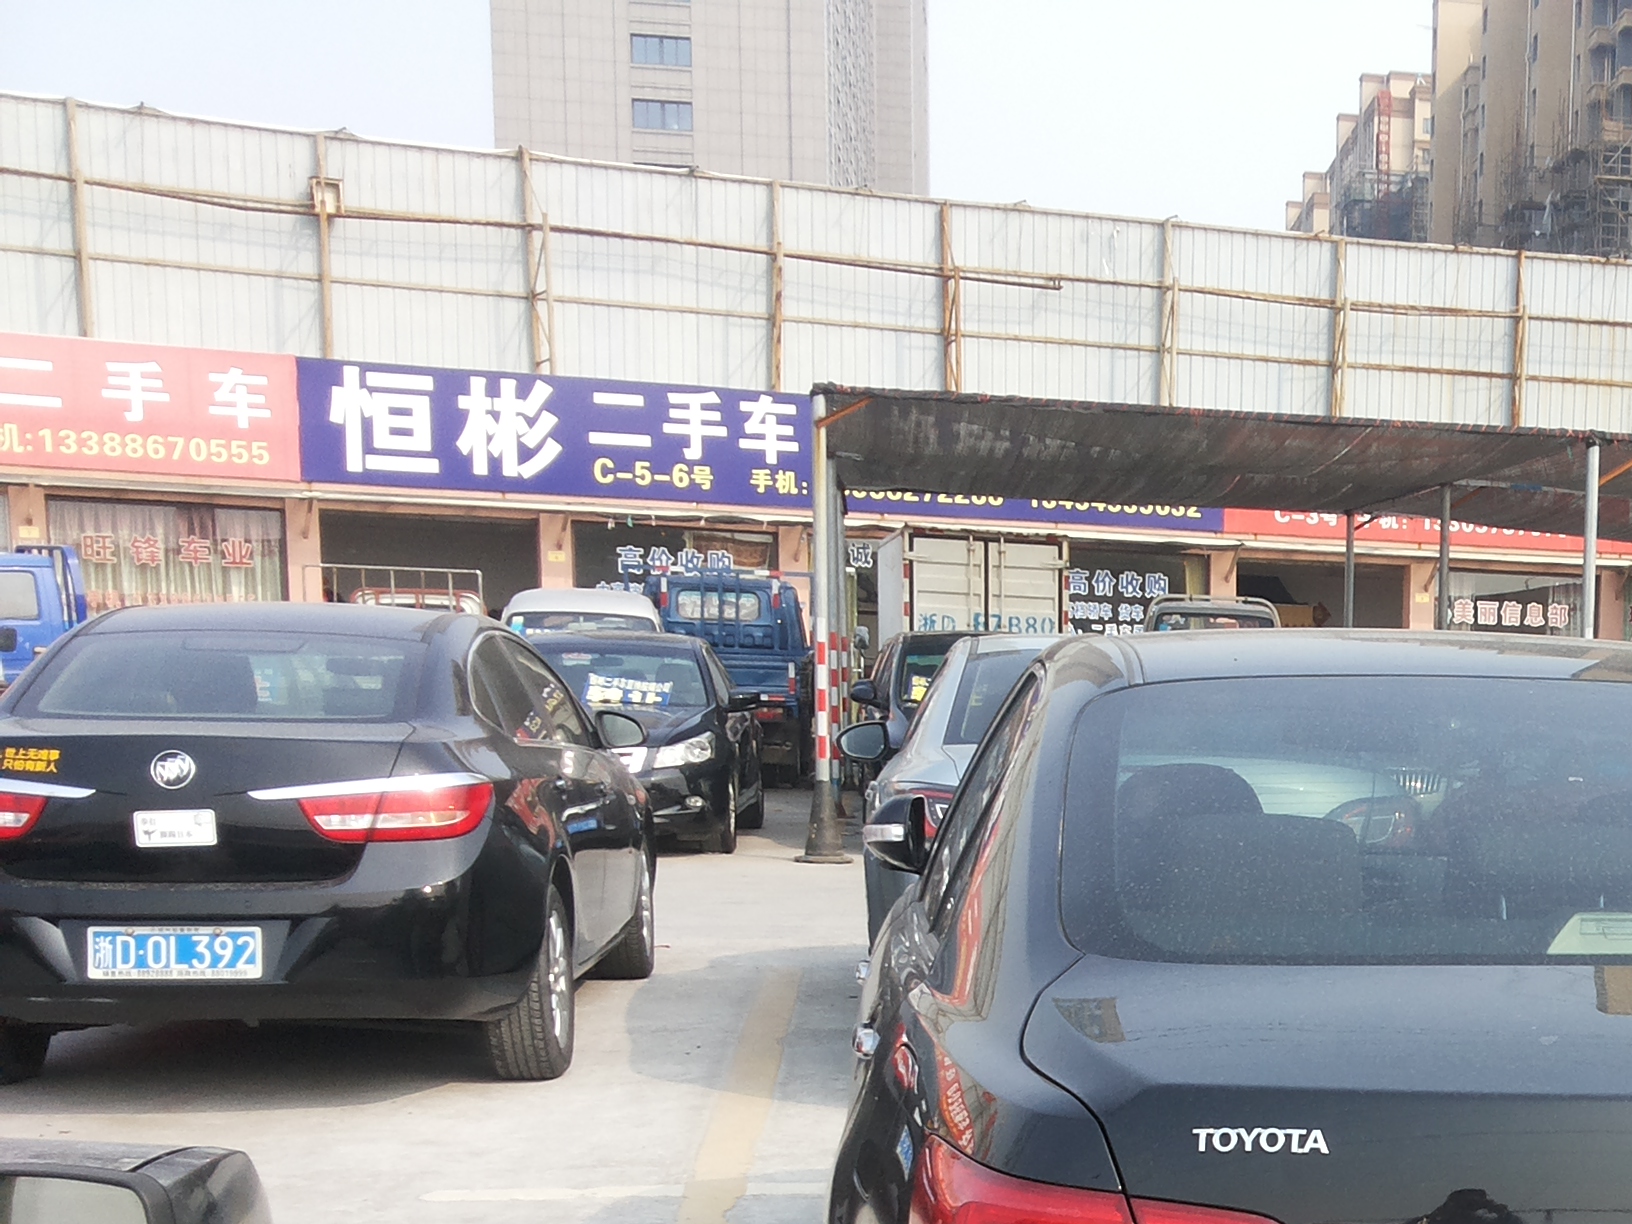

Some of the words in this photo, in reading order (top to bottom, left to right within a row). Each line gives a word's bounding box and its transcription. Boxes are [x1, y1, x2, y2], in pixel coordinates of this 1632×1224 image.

[0, 357, 272, 429] 二手车
[329, 365, 563, 480] 恒彬
[588, 390, 801, 465] 二手车
[81, 533, 255, 568] 旺锋车业
[616, 545, 735, 576] 高价收购
[1068, 568, 1169, 598] 高价收购
[1452, 598, 1570, 628] 美丽信息部
[1192, 1127, 1330, 1155] TOYOTA
